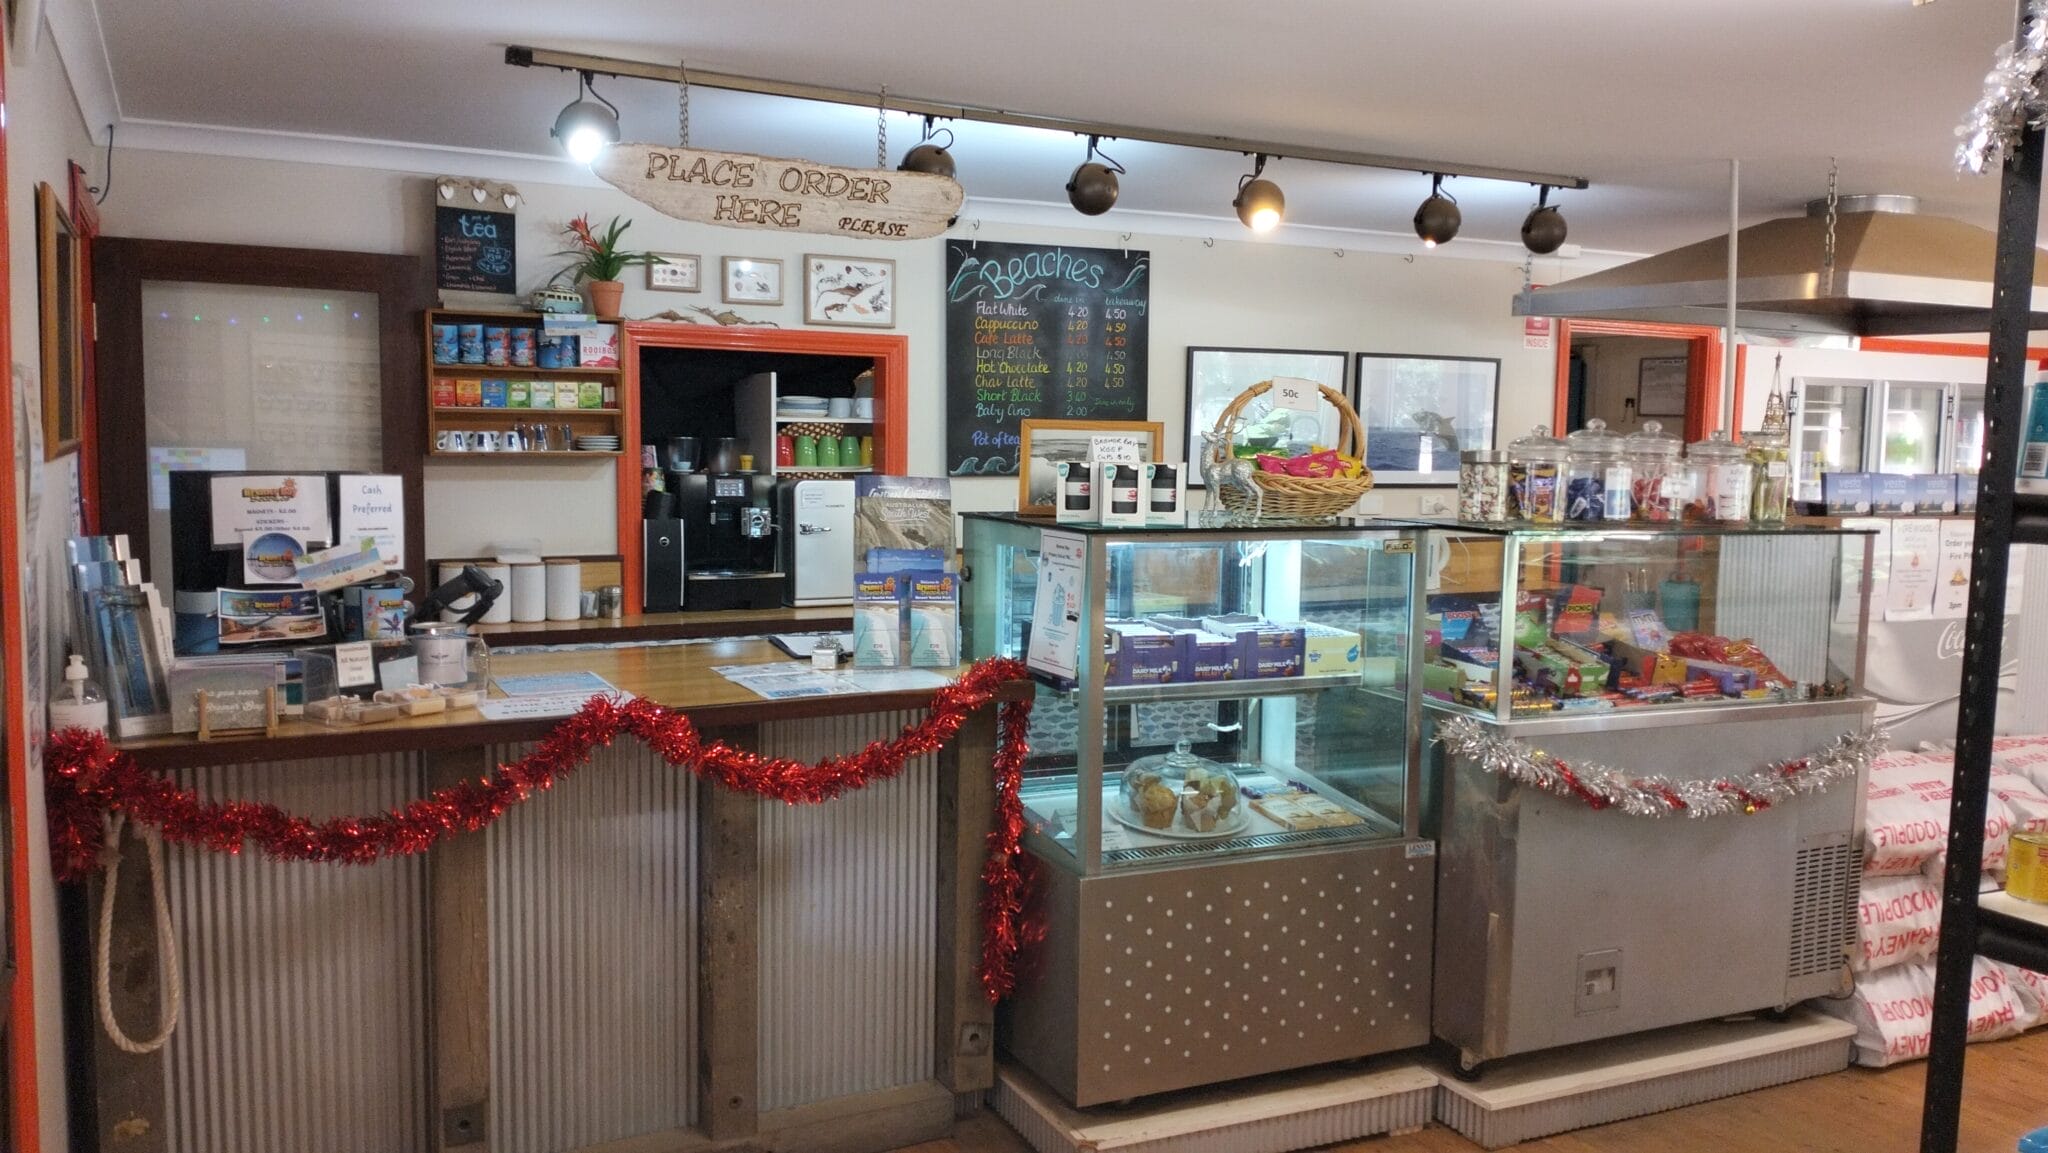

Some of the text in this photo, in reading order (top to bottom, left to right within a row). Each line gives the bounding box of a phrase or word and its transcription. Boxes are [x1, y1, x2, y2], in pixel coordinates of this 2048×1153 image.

[646, 152, 893, 204] PLACE ORDER
[714, 194, 908, 237] HERE PLEASE
[458, 214, 497, 238] tea
[979, 247, 1104, 299] Beaches
[976, 301, 1030, 317] Flat White
[1105, 296, 1146, 316] takeaway
[975, 316, 1039, 333] Cappuccino
[1003, 331, 1033, 345] Latte
[1526, 338, 1549, 348] INSIDE
[583, 346, 618, 355] ROOIBOS
[976, 347, 1043, 364] Long Black
[976, 361, 1050, 375] Hot Chocolate
[975, 375, 1036, 389] Chai Latte
[976, 390, 1043, 402] Short Black
[1282, 389, 1300, 399] 50c
[975, 403, 1031, 424] Baby Cino
[971, 431, 1021, 447] Pot of tea
[361, 484, 383, 495] Cash
[352, 503, 393, 516] Preferred
[879, 508, 930, 522] South West
[1945, 539, 1963, 547] Order
[1949, 552, 1964, 560] Fire
[1567, 604, 1593, 612] PICNIC
[1132, 666, 1148, 674] DAIRY
[1195, 664, 1224, 673] DAIRY MILK
[1258, 660, 1287, 669] DAIRY MILK
[1860, 890, 1939, 925] WOODPILE
